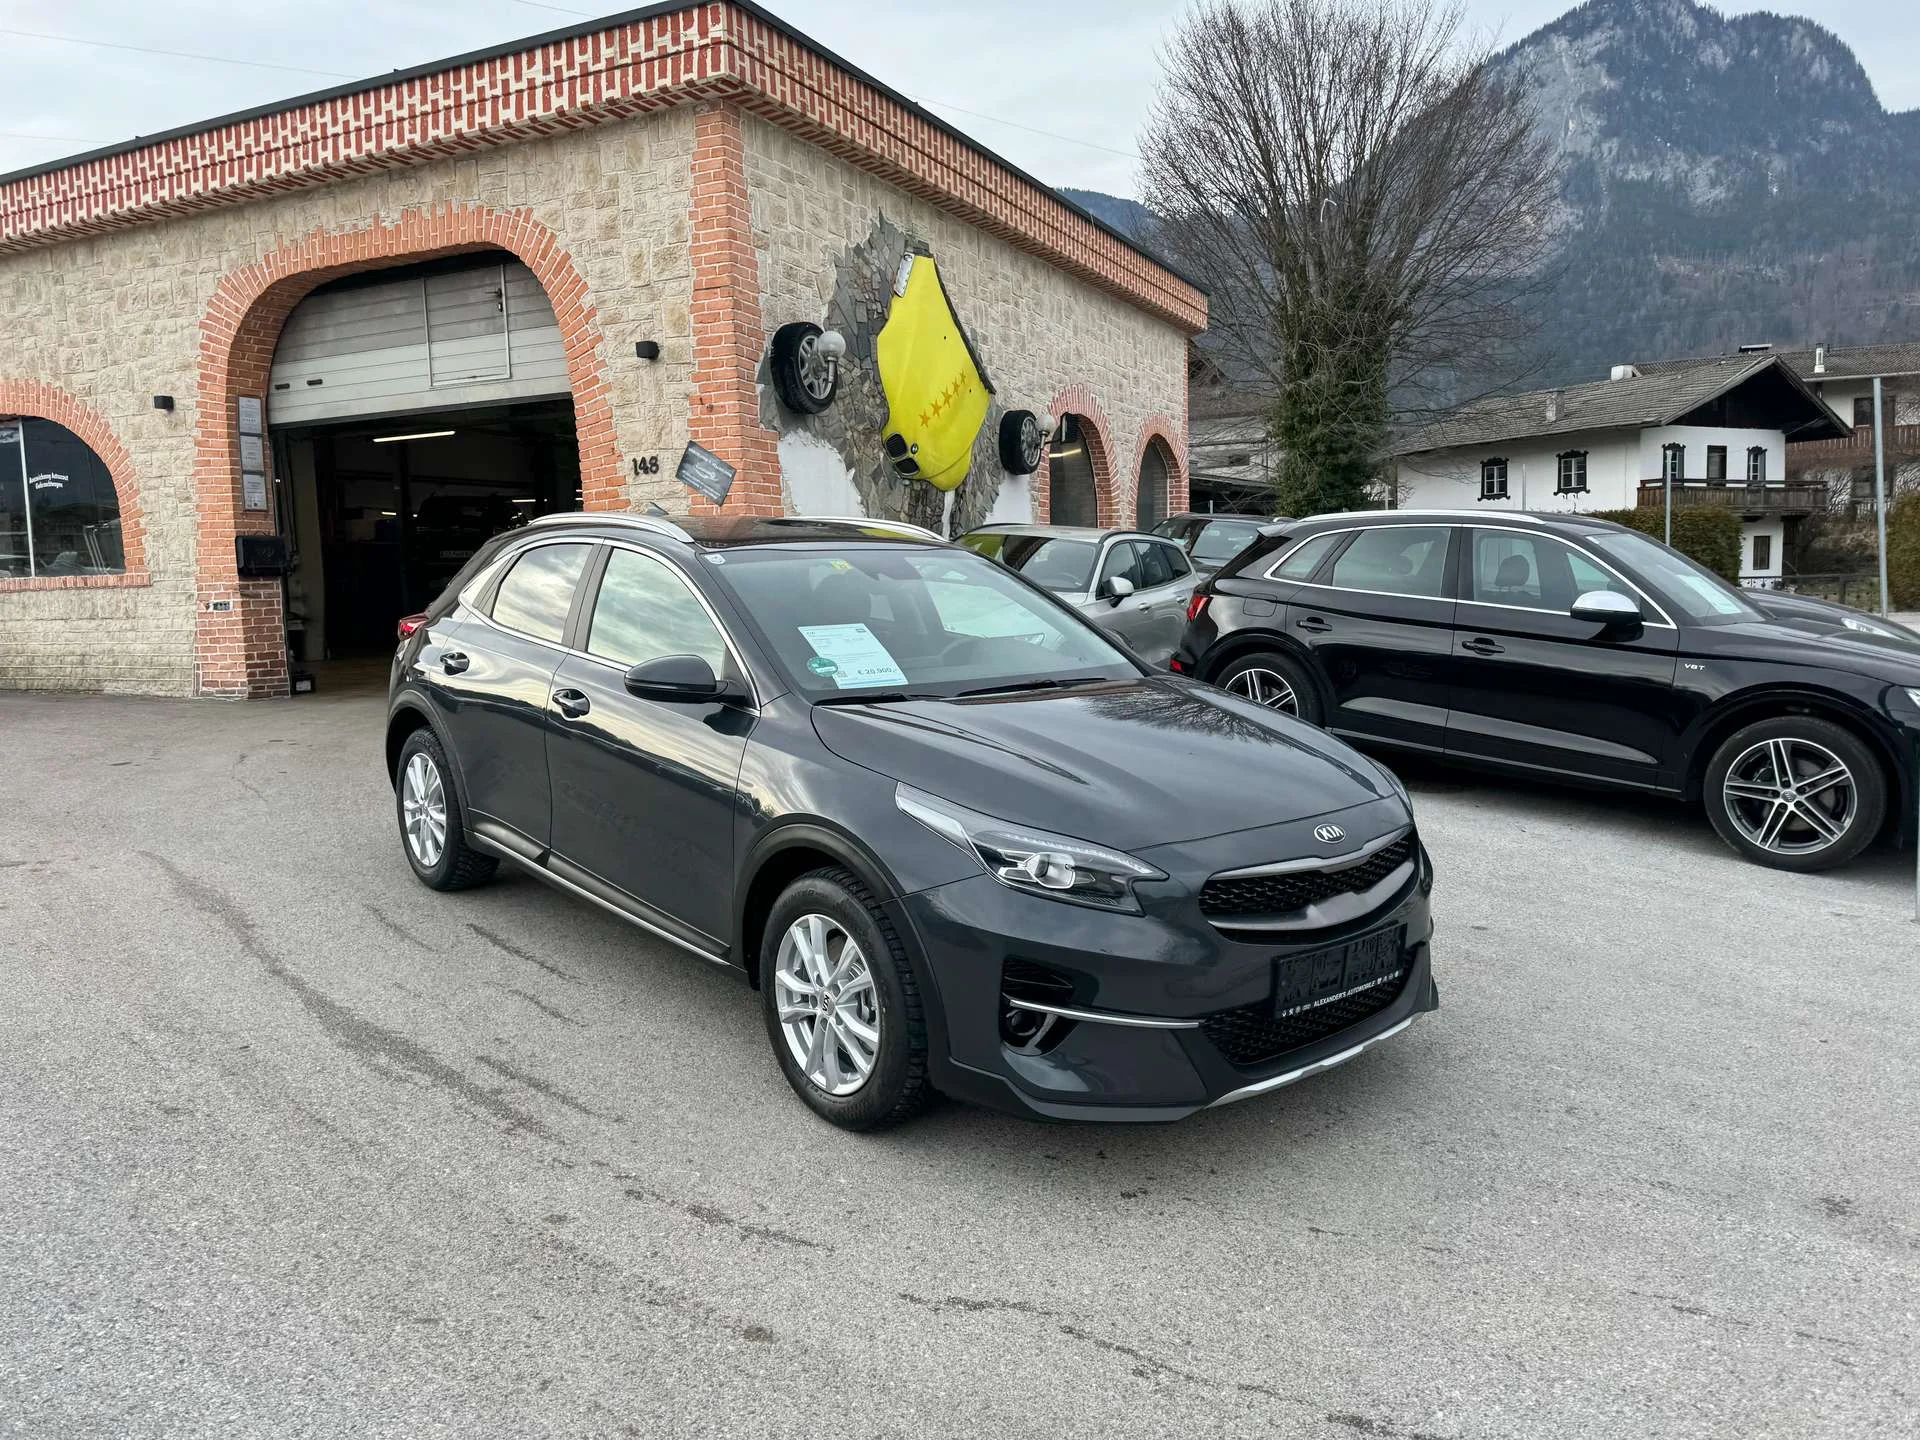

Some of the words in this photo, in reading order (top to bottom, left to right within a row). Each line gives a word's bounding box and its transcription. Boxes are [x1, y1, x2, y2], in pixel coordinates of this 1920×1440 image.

[632, 455, 659, 476] 148
[1317, 825, 1344, 841] KIA
[1313, 991, 1347, 1007] ALEXANDER'S
[1346, 980, 1376, 996] AUTOMOBILE
